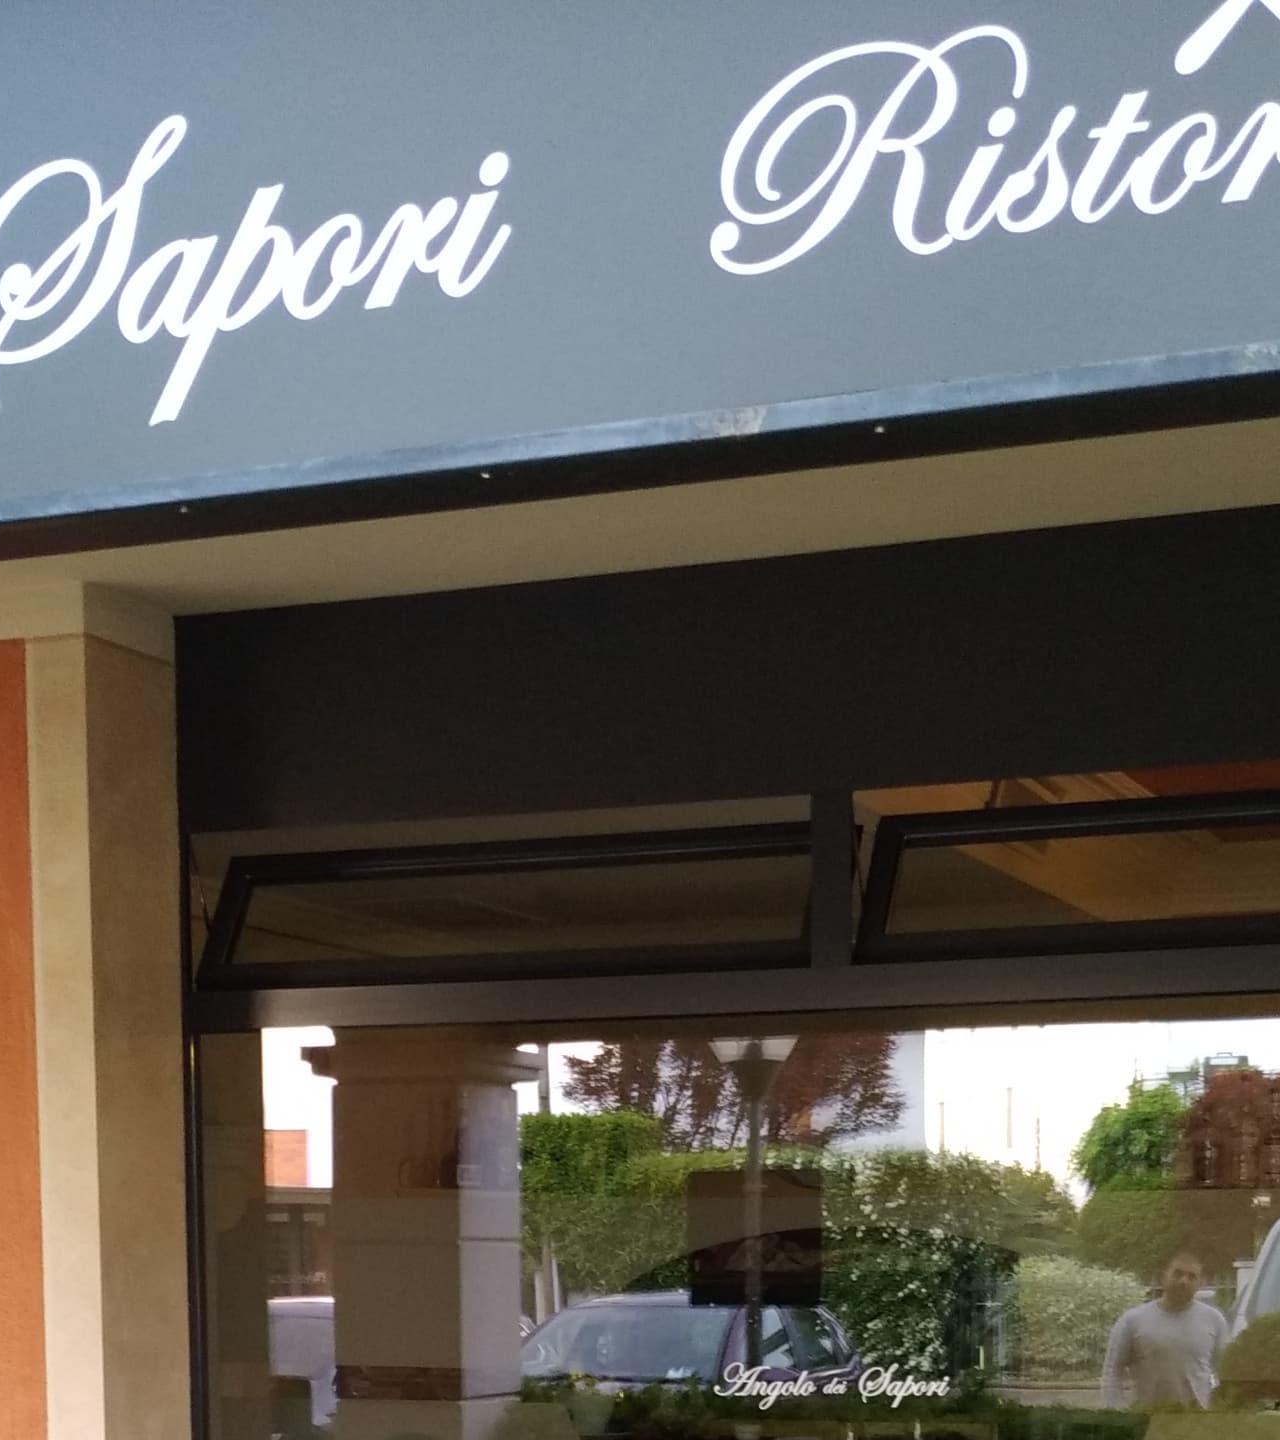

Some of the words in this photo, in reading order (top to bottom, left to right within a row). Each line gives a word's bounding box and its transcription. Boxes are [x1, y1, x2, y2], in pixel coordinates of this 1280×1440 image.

[713, 1362, 816, 1410] Angolo
[822, 1377, 848, 1395] dei
[857, 1363, 950, 1408] Sapori
